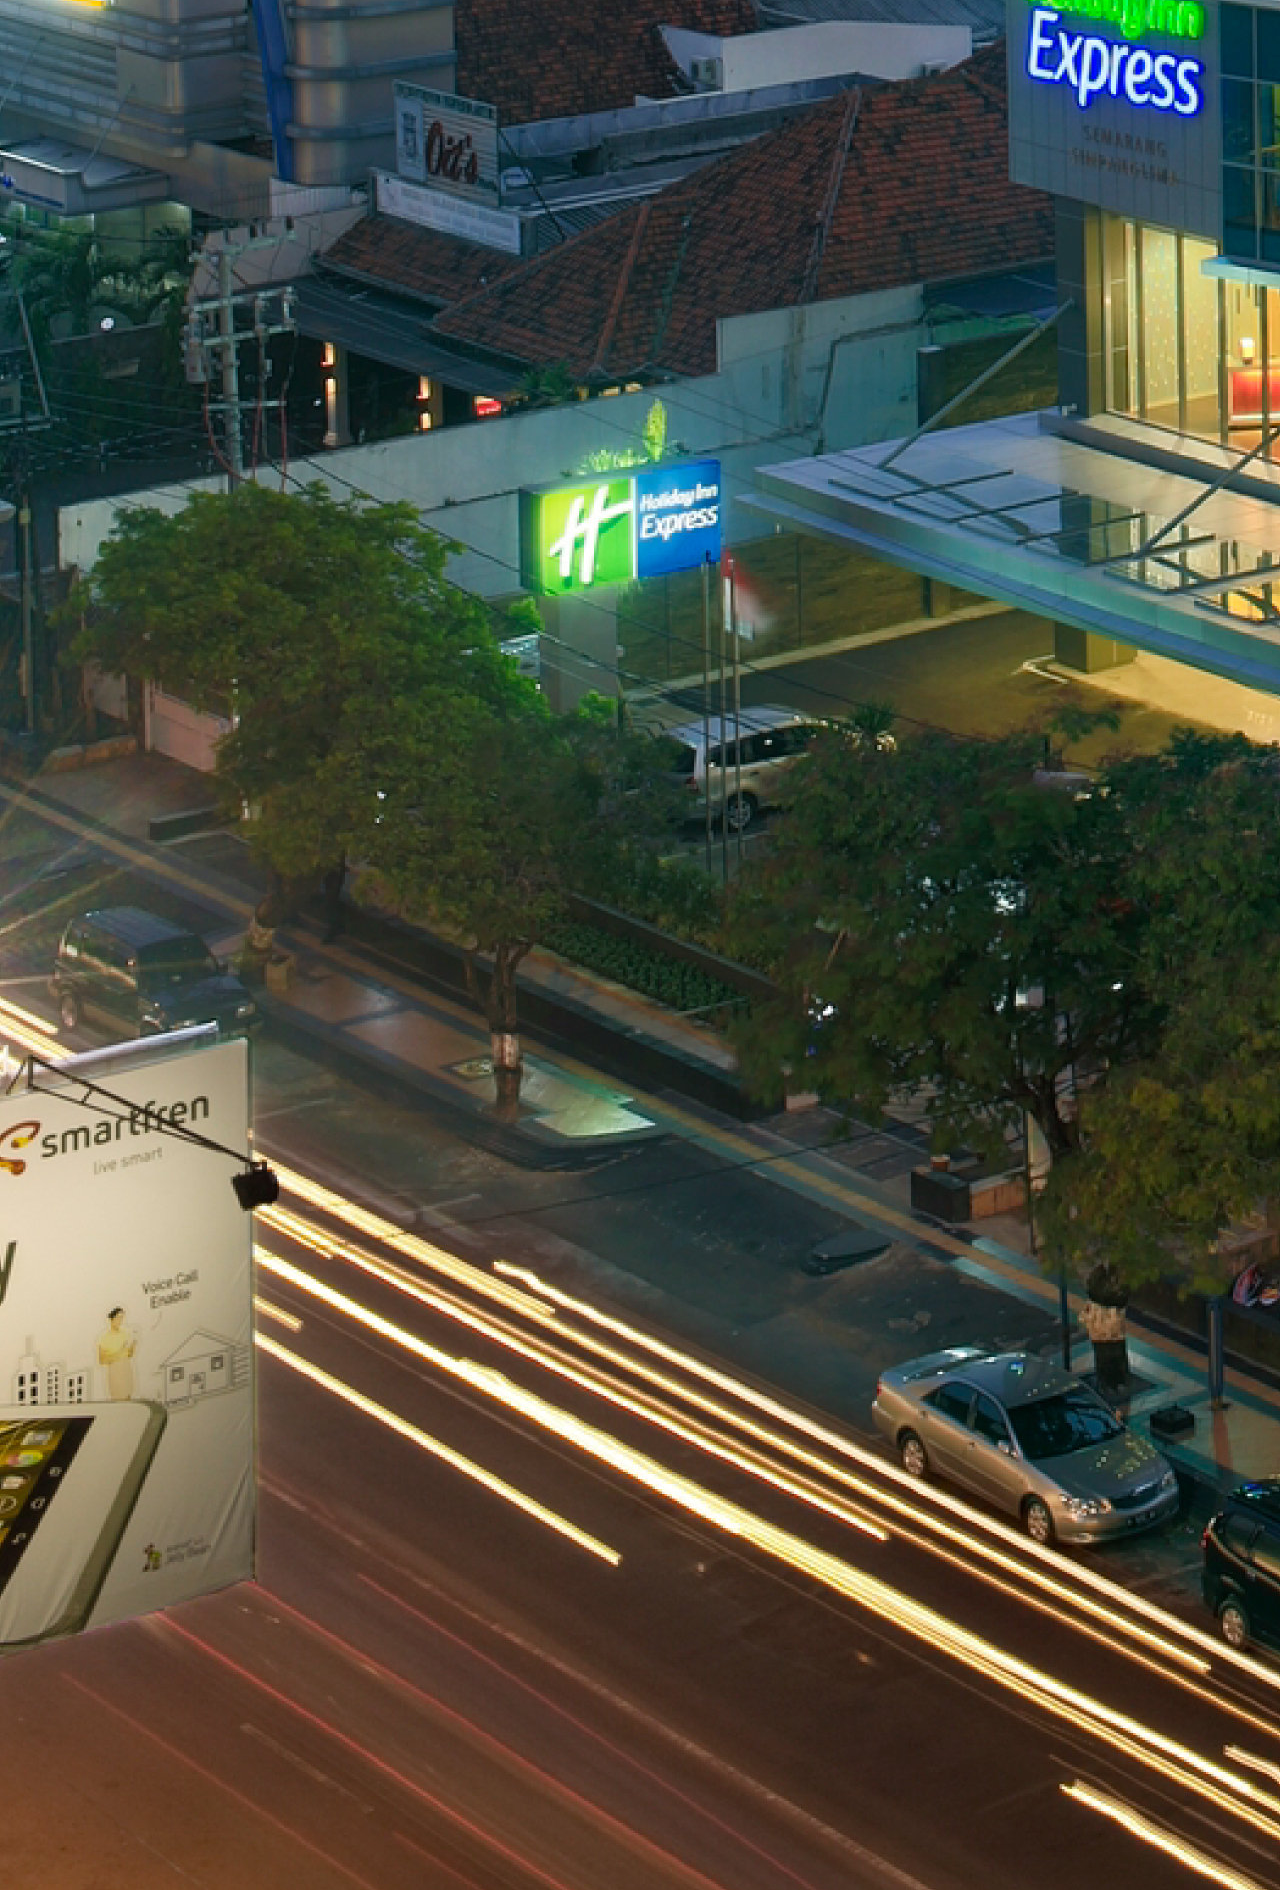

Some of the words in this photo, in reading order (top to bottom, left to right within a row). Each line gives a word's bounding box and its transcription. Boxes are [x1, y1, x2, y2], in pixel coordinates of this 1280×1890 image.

[1028, 8, 1203, 117] Express
[1082, 124, 1168, 158] SEMARANG
[640, 488, 695, 512] Holiday
[695, 483, 718, 500] Inn
[640, 505, 718, 541] Express
[41, 1096, 209, 1158] smartfren
[94, 1156, 117, 1175] live
[120, 1147, 163, 1168] smart
[142, 1278, 172, 1294] Voice
[151, 1289, 191, 1309] Enable
